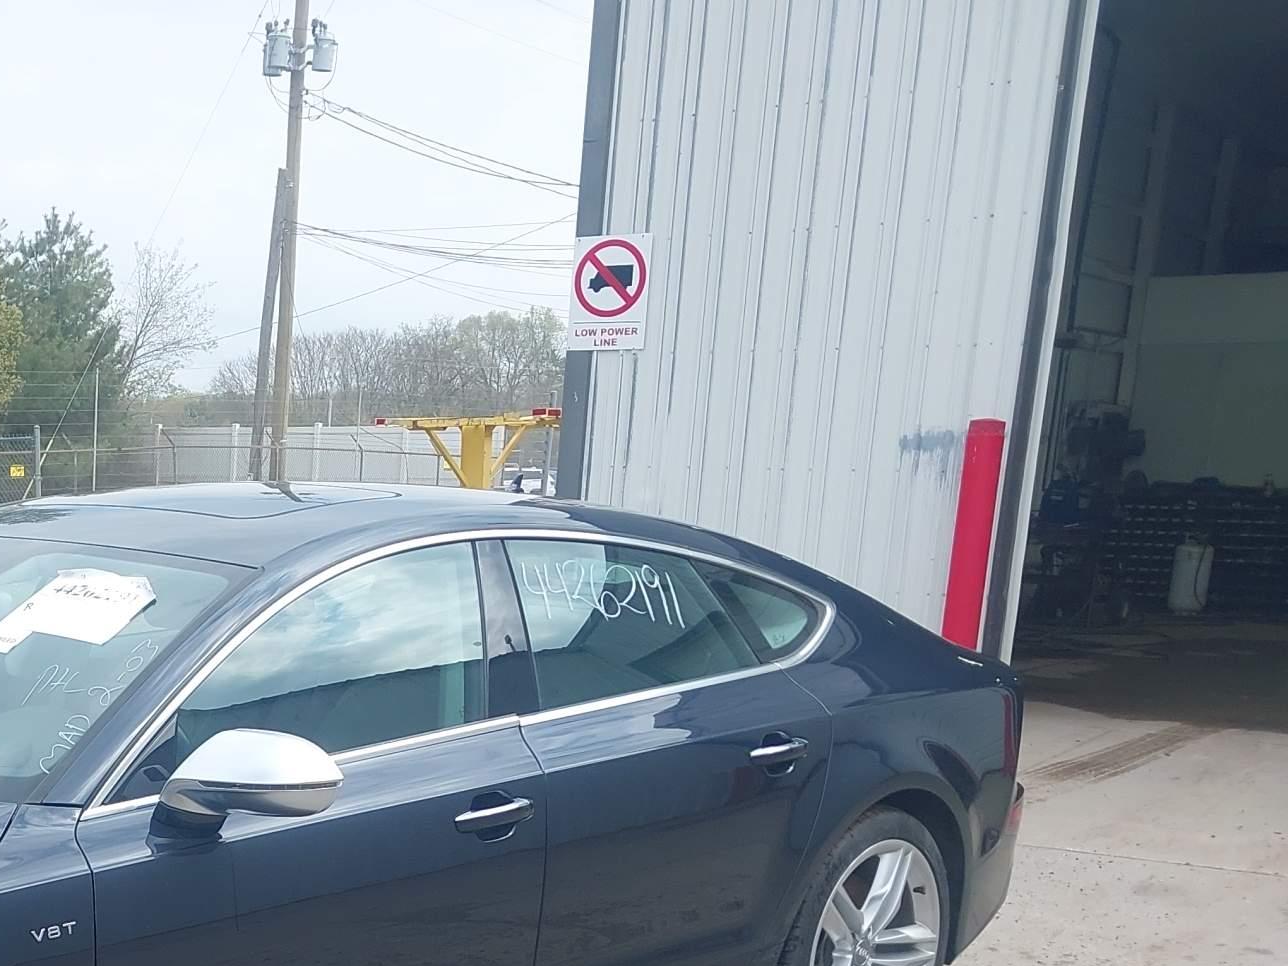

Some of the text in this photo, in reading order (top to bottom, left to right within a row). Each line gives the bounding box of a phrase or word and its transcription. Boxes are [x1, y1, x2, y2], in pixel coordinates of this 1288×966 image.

[574, 327, 638, 337] LOW POWER
[593, 338, 618, 347] LINE
[521, 559, 686, 629] 44262191
[39, 714, 91, 774] MAD
[30, 920, 77, 942] V8T
